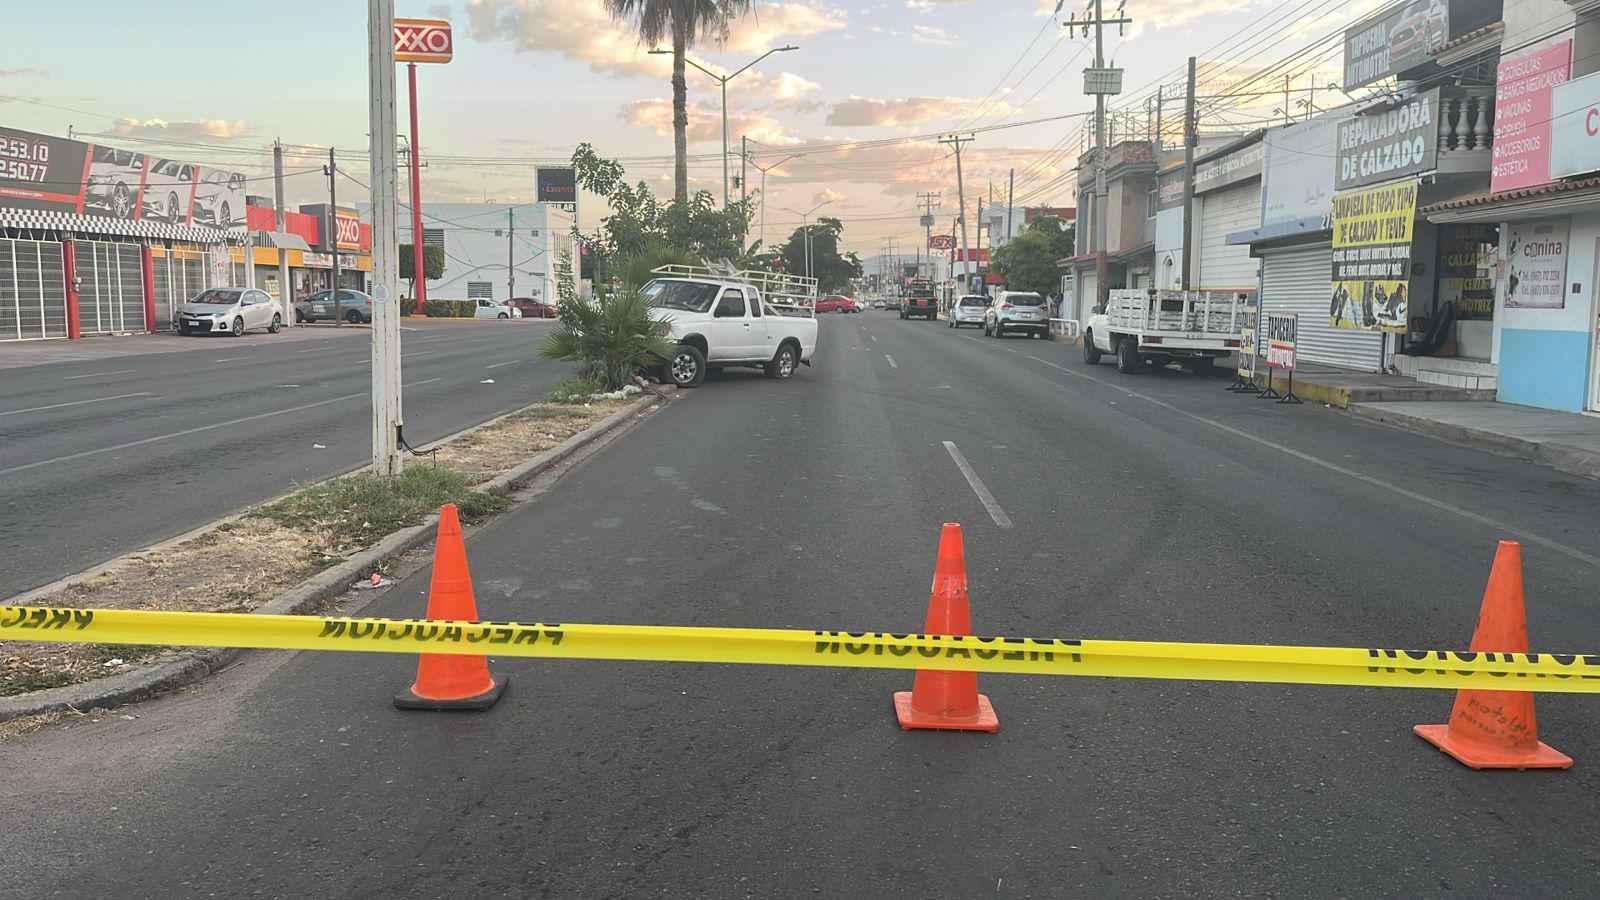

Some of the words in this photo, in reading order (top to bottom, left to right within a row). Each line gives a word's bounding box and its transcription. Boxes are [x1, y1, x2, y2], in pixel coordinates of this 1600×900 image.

[394, 27, 449, 52] XXO
[1504, 57, 1541, 80] CONSULTAS
[1526, 68, 1566, 92] MEDICADOS
[1502, 99, 1532, 118] VACUNAS
[1341, 97, 1430, 150] REPARADORA
[1341, 154, 1358, 181] DE
[1360, 135, 1425, 177] CALZADO
[1500, 136, 1542, 157] ACCESORIOS
[1335, 194, 1364, 219] LIMPIEZA
[1366, 192, 1375, 215] DE
[1376, 189, 1395, 213] TODO
[1397, 185, 1414, 210] TIPO
[1340, 223, 1348, 244] DE
[1349, 219, 1378, 243] CALZADO
[1380, 218, 1385, 240] Y
[1386, 215, 1406, 240] TENIS
